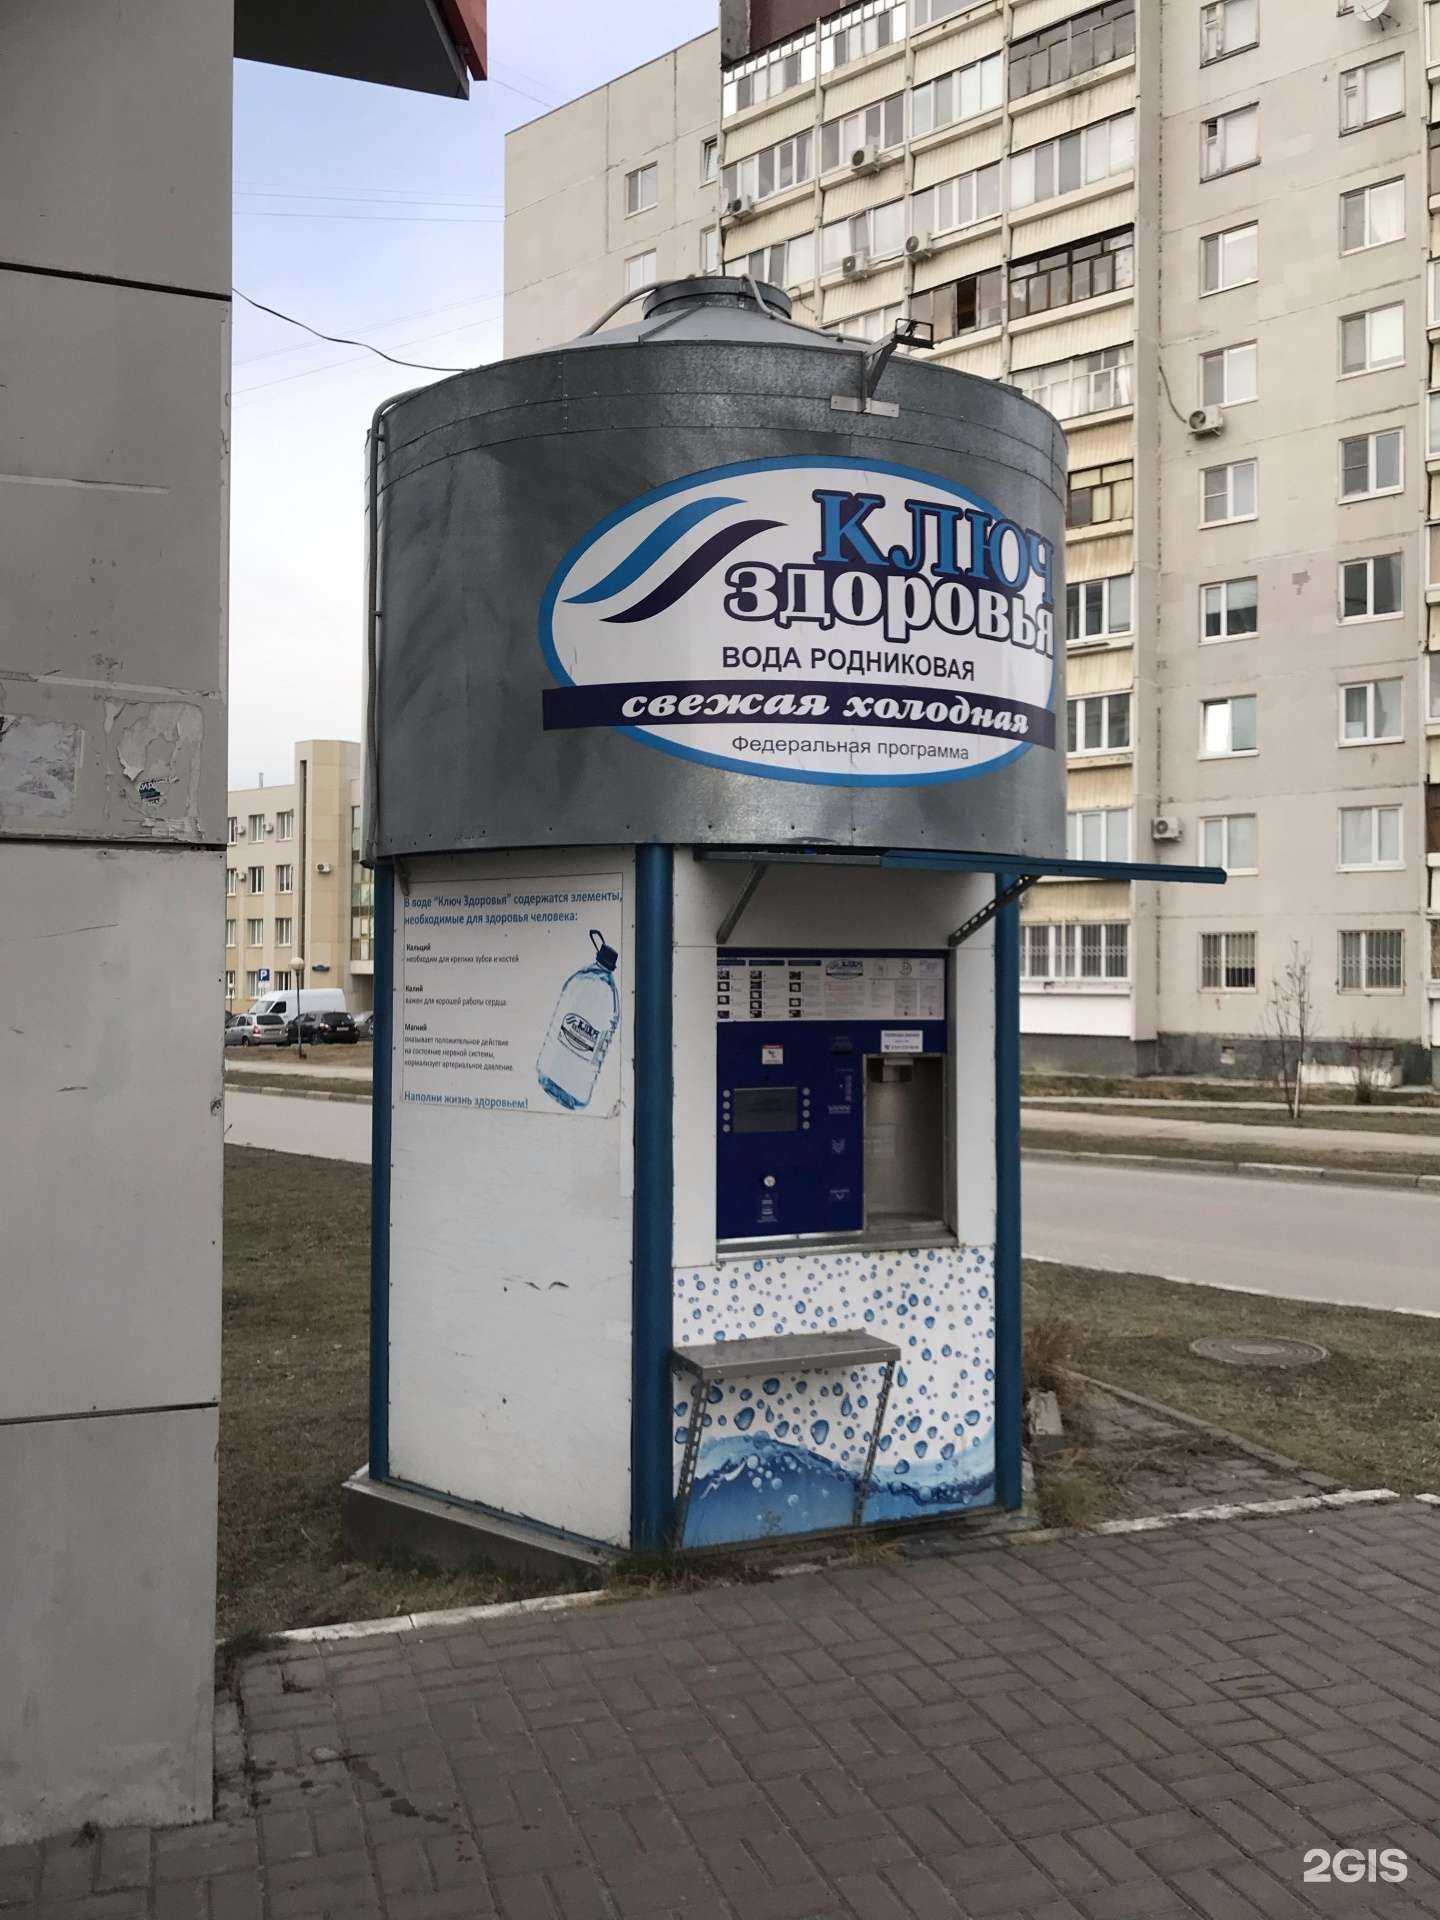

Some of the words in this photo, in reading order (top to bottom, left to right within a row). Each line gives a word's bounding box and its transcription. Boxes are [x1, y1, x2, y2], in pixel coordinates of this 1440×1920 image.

[812, 488, 1053, 605] КЛЮЧ
[723, 561, 1053, 659] здоровья
[722, 646, 802, 672] ВОДА
[810, 647, 975, 681] РОДНИКОВАЯ
[621, 692, 830, 717] свежая
[842, 696, 1030, 735] холодная
[732, 734, 870, 755] Федеральная
[877, 743, 969, 761] программа
[412, 899, 432, 909] воде
[513, 894, 568, 906] содержатся
[571, 891, 623, 902] элементы,
[404, 913, 465, 926] необходимые
[466, 914, 483, 925] для
[486, 912, 528, 925] здоровья
[531, 911, 578, 922] человека:
[406, 943, 431, 952] Кальций
[405, 984, 423, 992] Калий
[404, 1023, 427, 1031] Магний
[404, 1091, 442, 1102] Наполни
[444, 1095, 472, 1106] жизнь
[474, 1098, 528, 1109] здоровьем!
